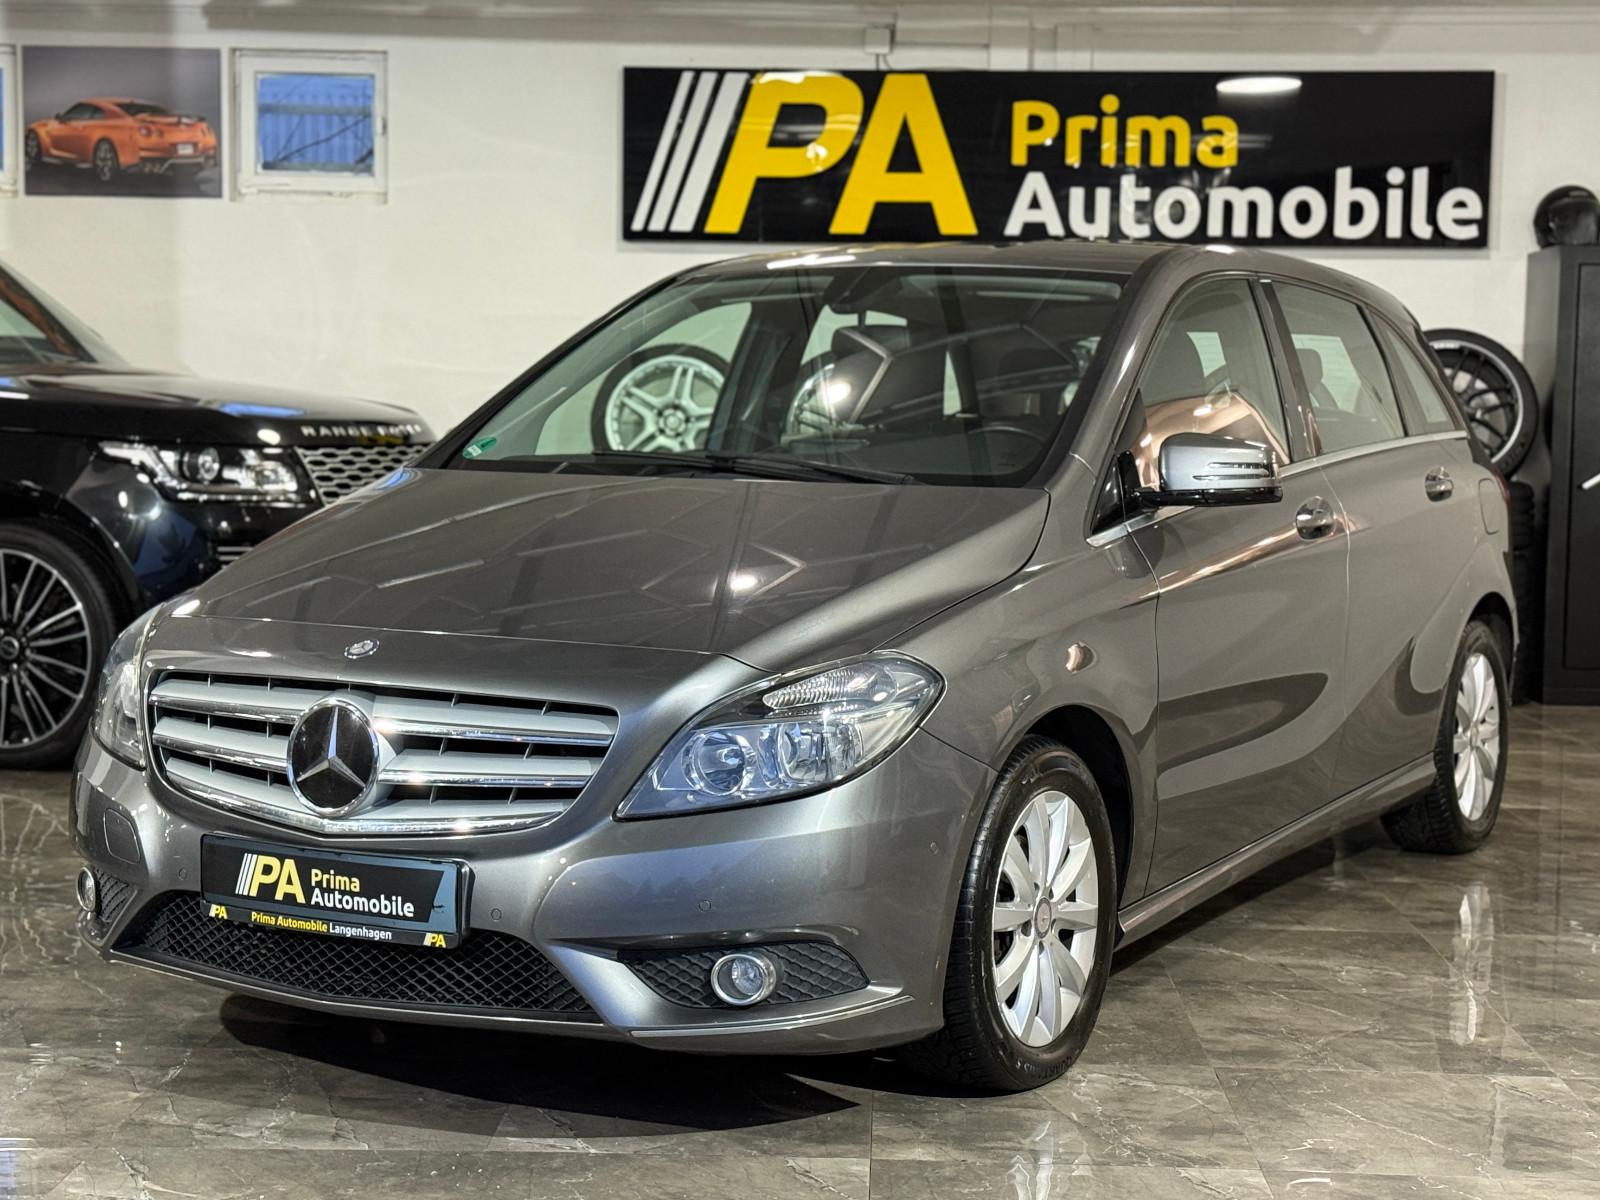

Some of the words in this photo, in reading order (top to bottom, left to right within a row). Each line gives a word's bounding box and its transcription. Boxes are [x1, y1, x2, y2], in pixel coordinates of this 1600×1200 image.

[1011, 94, 1239, 168] Prima
[704, 72, 979, 236] PA
[1003, 165, 1483, 240] Automobile
[249, 855, 306, 904] PA
[311, 868, 360, 892] Prima
[212, 904, 228, 919] PA
[311, 887, 414, 917] Automobile
[251, 911, 276, 925] Prima
[277, 916, 328, 932] Automobile
[329, 922, 392, 940] Langenhagen
[428, 933, 447, 948] PA
